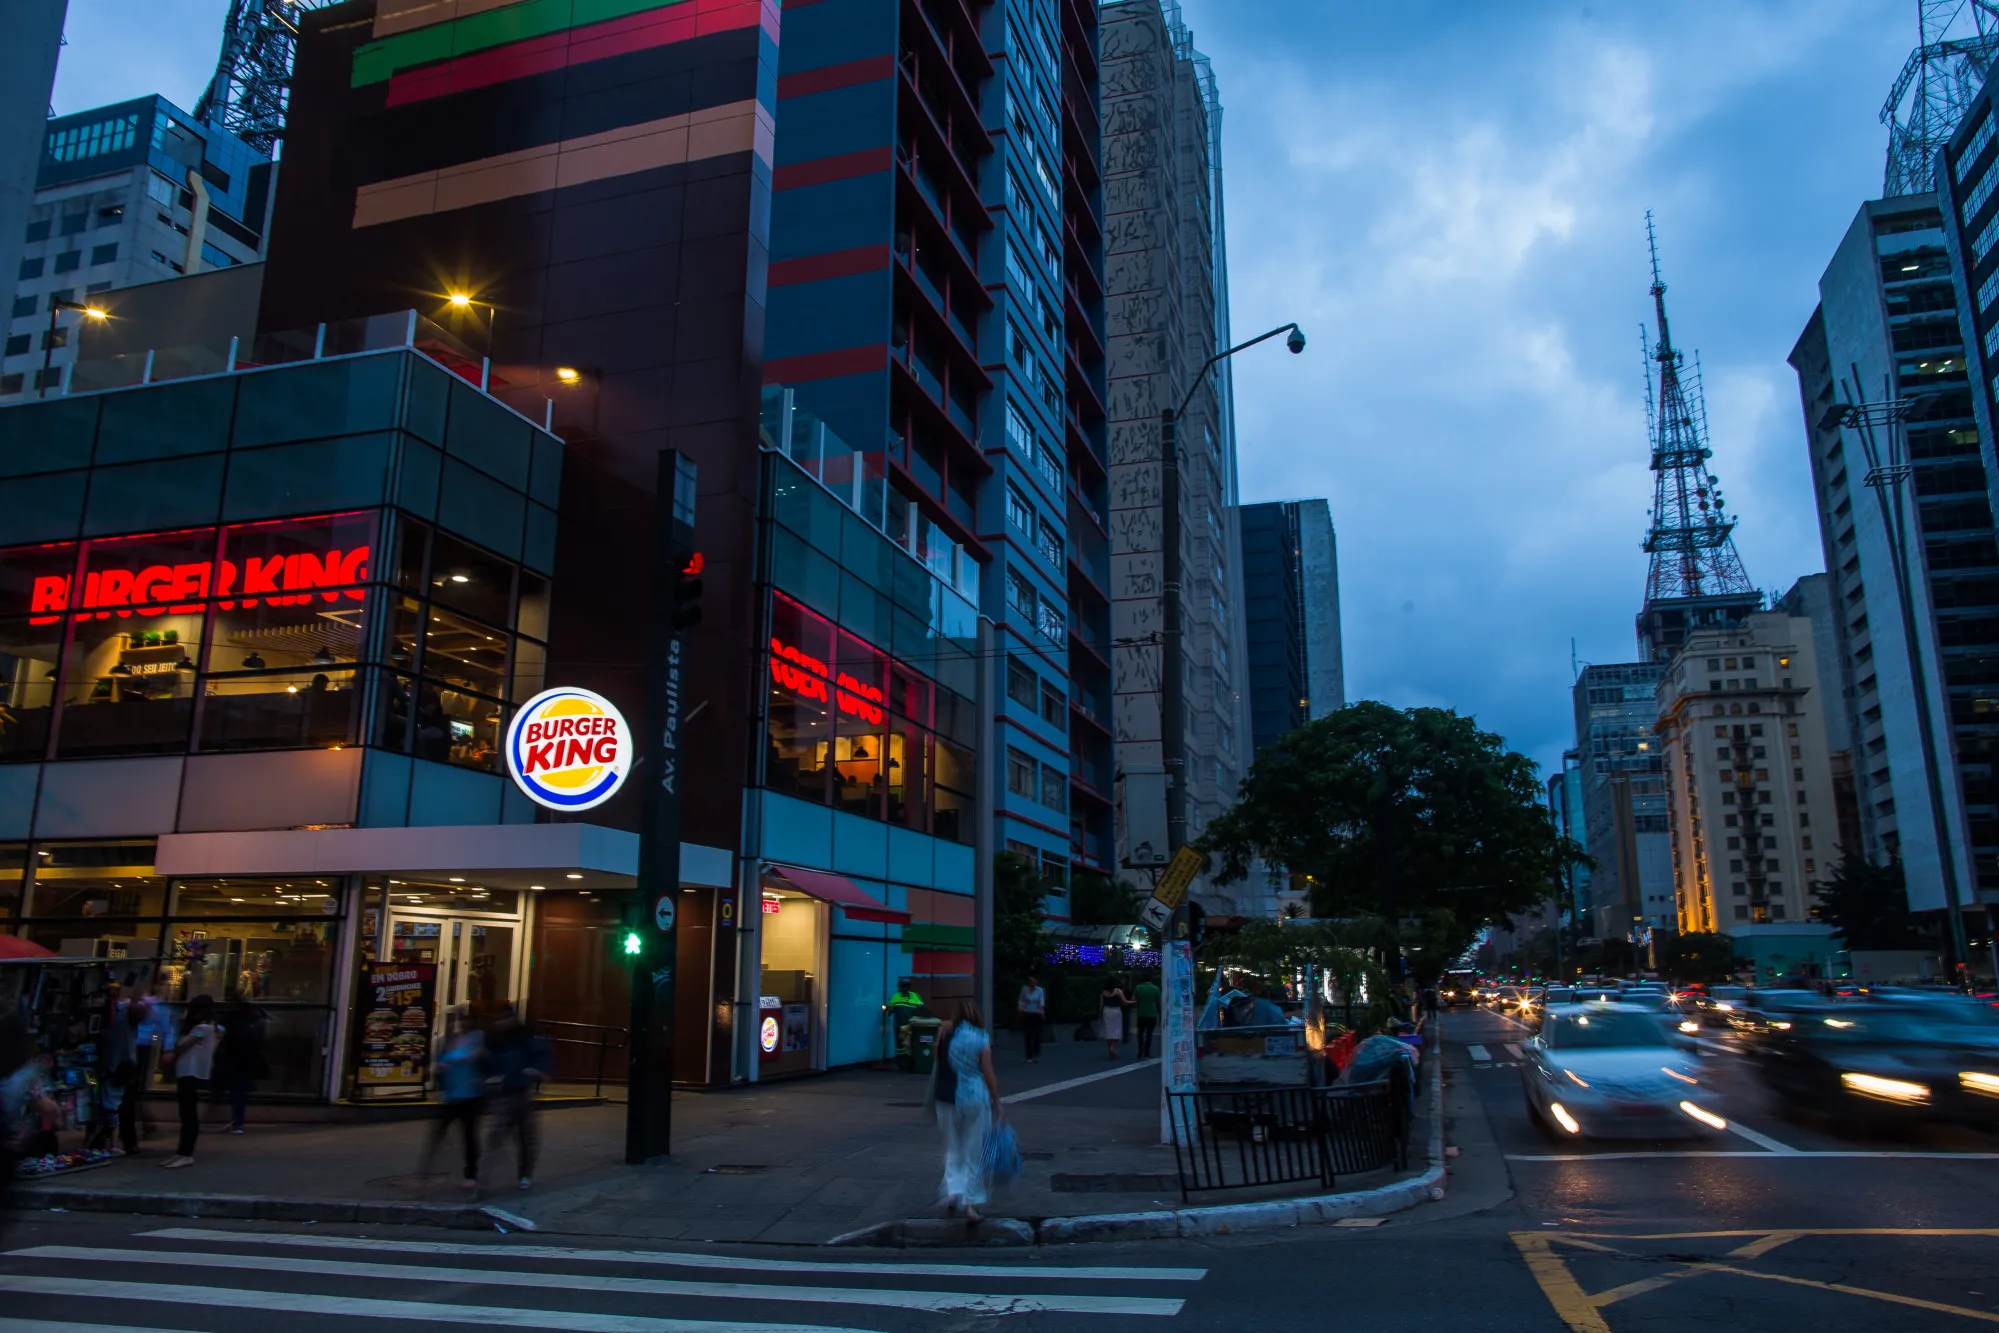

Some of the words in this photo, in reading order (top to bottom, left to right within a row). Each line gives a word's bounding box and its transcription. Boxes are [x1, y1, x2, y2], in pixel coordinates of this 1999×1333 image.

[29, 559, 237, 626] BURGER
[242, 546, 370, 609] KING
[663, 638, 681, 750] Paulista
[526, 717, 616, 744] BURGER
[524, 736, 618, 774] KING
[661, 756, 676, 795] Av.
[371, 973, 385, 984] EM
[386, 970, 417, 982] DOBRO
[375, 986, 386, 1002] 2
